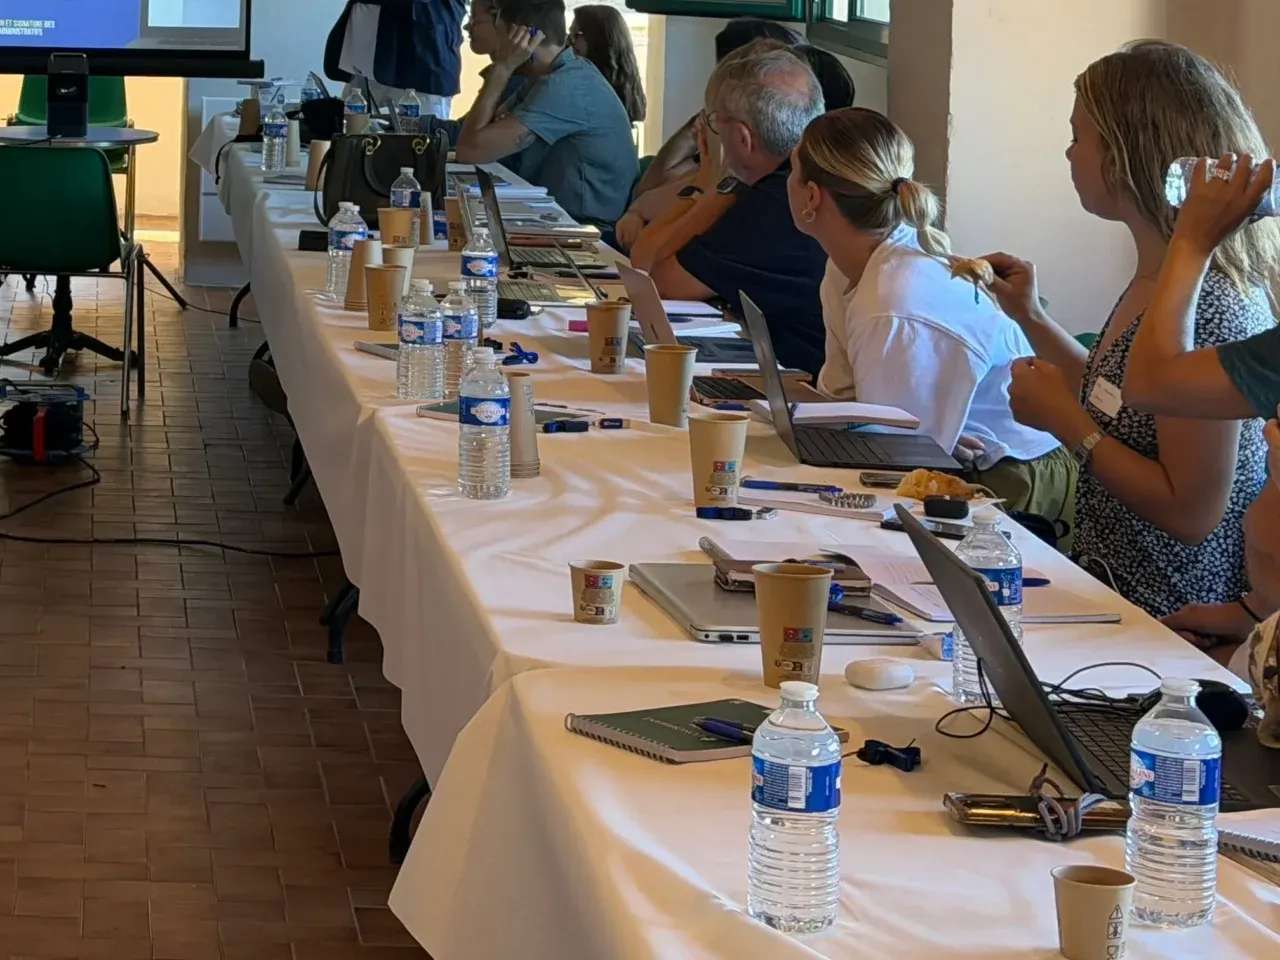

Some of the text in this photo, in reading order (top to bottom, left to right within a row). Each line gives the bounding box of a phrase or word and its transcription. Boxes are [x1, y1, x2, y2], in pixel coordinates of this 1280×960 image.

[5, 19, 13, 27] ET
[12, 19, 44, 28] SIGNATURE
[43, 20, 56, 28] DES
